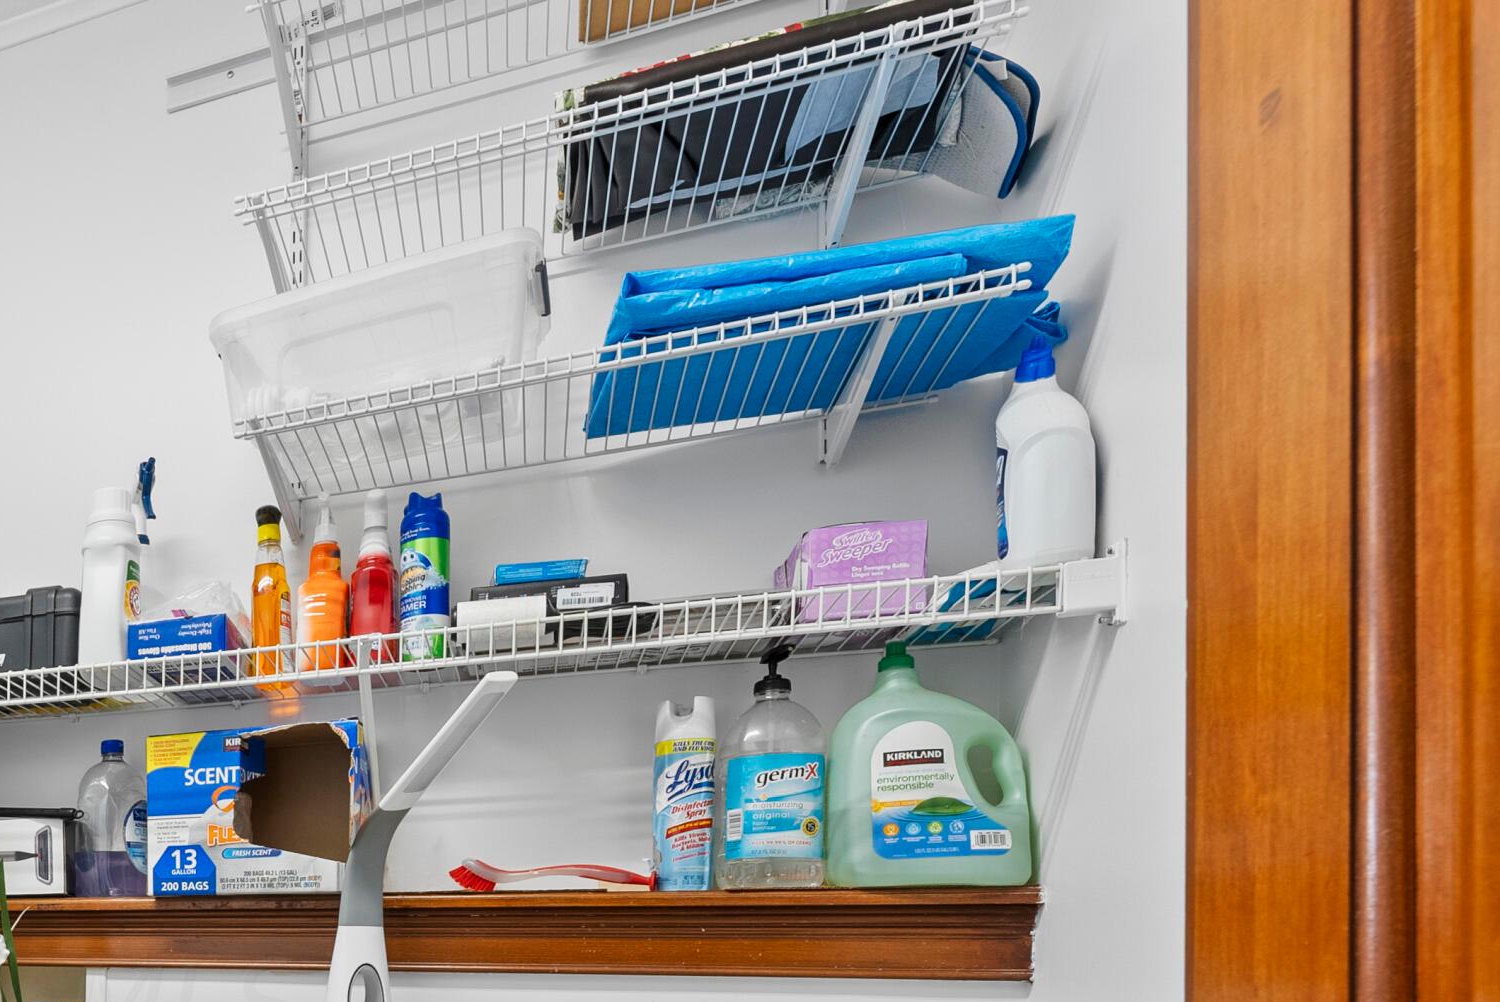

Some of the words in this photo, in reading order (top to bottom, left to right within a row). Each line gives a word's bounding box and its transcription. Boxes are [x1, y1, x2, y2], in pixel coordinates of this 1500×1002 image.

[832, 528, 883, 550] Swiffer
[817, 538, 892, 568] Sweeper
[886, 750, 942, 761] KIRKLAND
[877, 772, 955, 784] environmentally
[877, 782, 934, 792] responsible
[685, 809, 707, 819] Spray
[171, 849, 197, 870] 13
[161, 883, 180, 891] 200
[182, 881, 209, 890] BAGS
